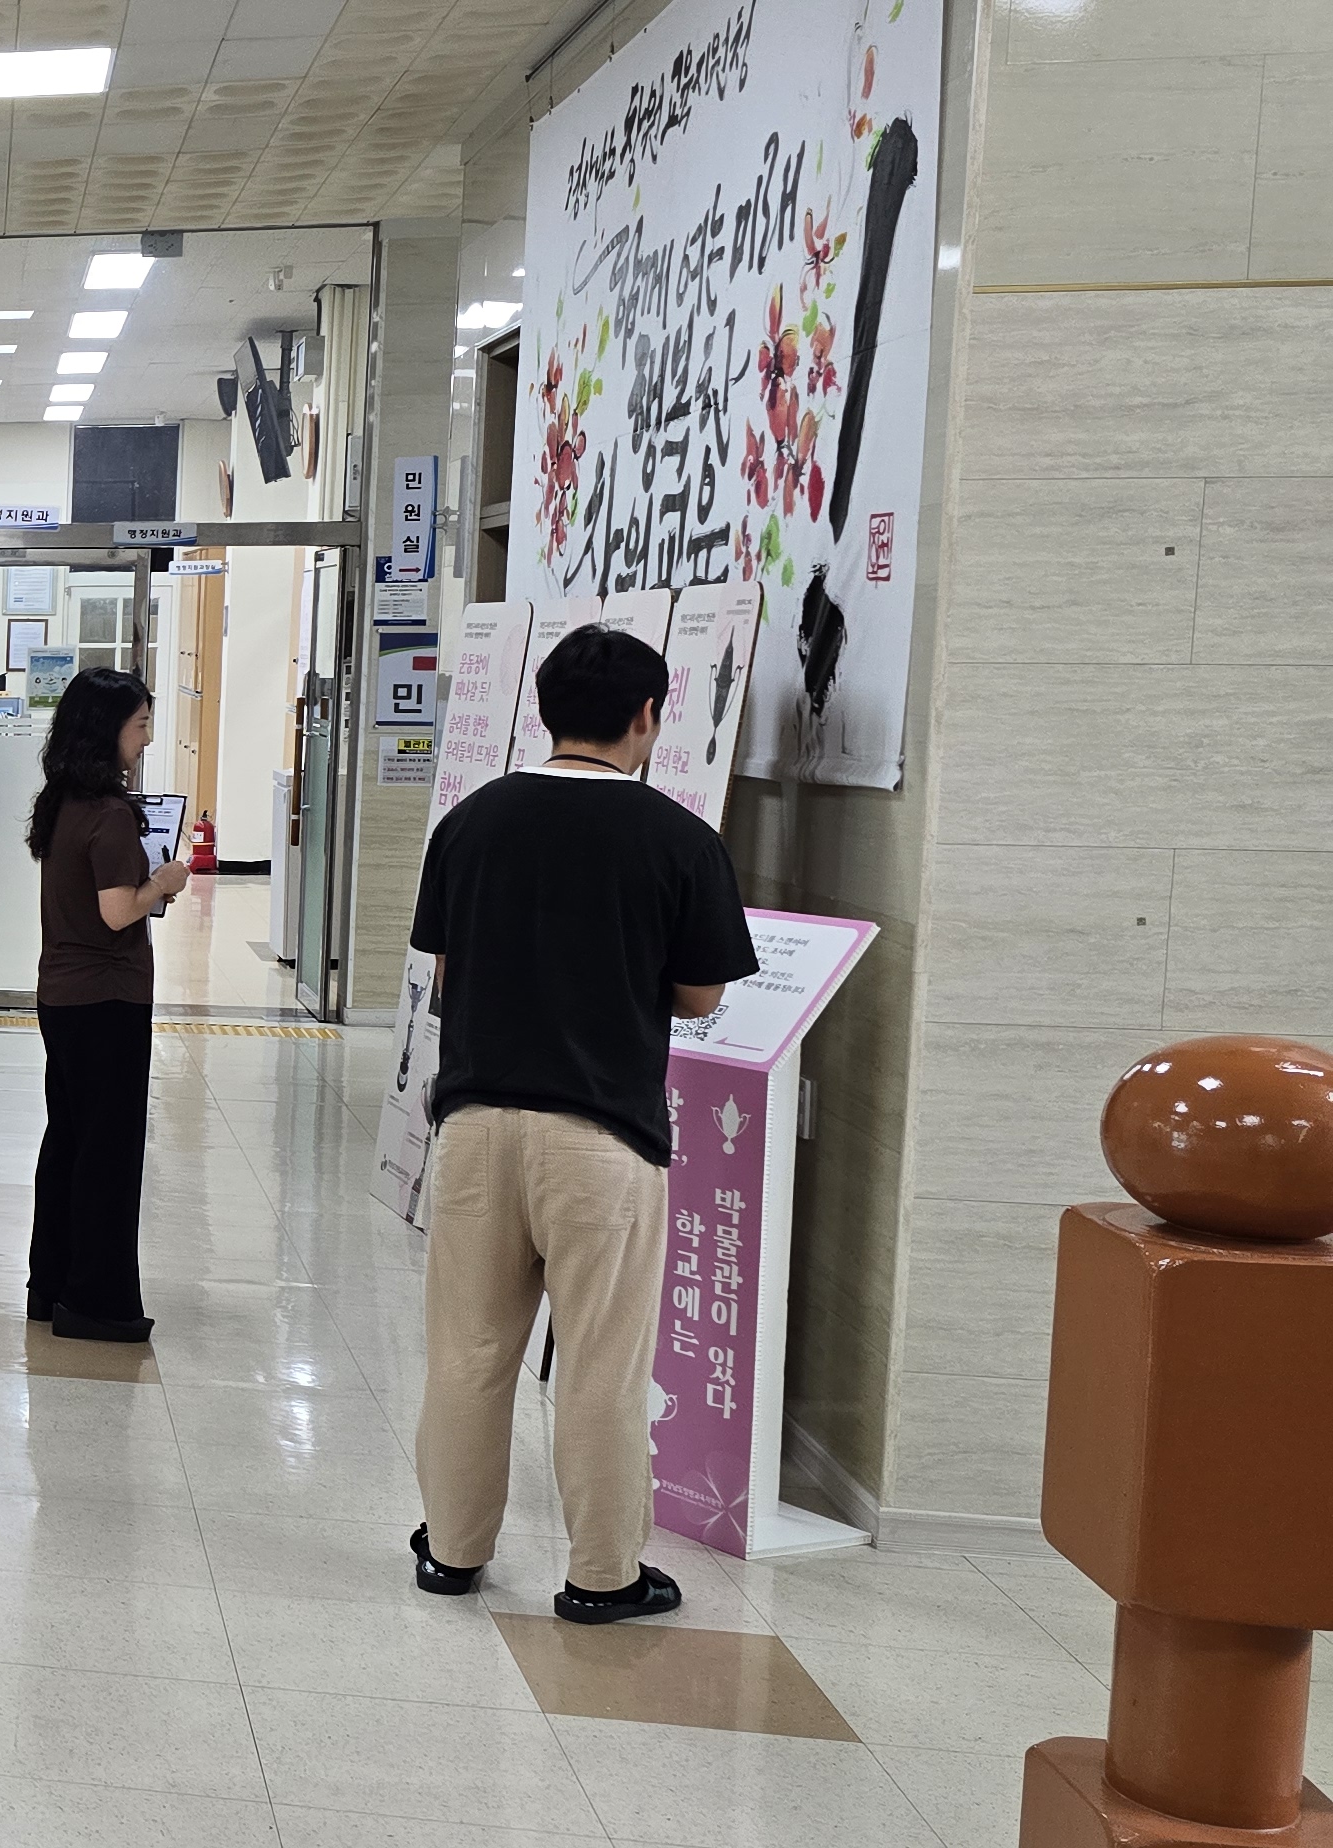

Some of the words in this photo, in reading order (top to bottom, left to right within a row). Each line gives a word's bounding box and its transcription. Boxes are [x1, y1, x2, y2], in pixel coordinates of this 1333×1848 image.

[675, 184, 725, 317] 여는
[730, 131, 807, 284] 미래
[627, 307, 751, 493] 행복한
[402, 472, 422, 553] 민원실
[458, 652, 491, 676] 운동장이
[392, 683, 423, 714] 민
[448, 713, 472, 737] 승리를
[444, 739, 476, 763] 우리들의
[653, 745, 671, 774] 우리
[672, 745, 691, 776] 학교
[439, 772, 463, 806] 함성
[670, 1210, 707, 1358] 학교에는
[710, 1188, 746, 1336] 박물관이
[705, 1347, 737, 1419] 있다
